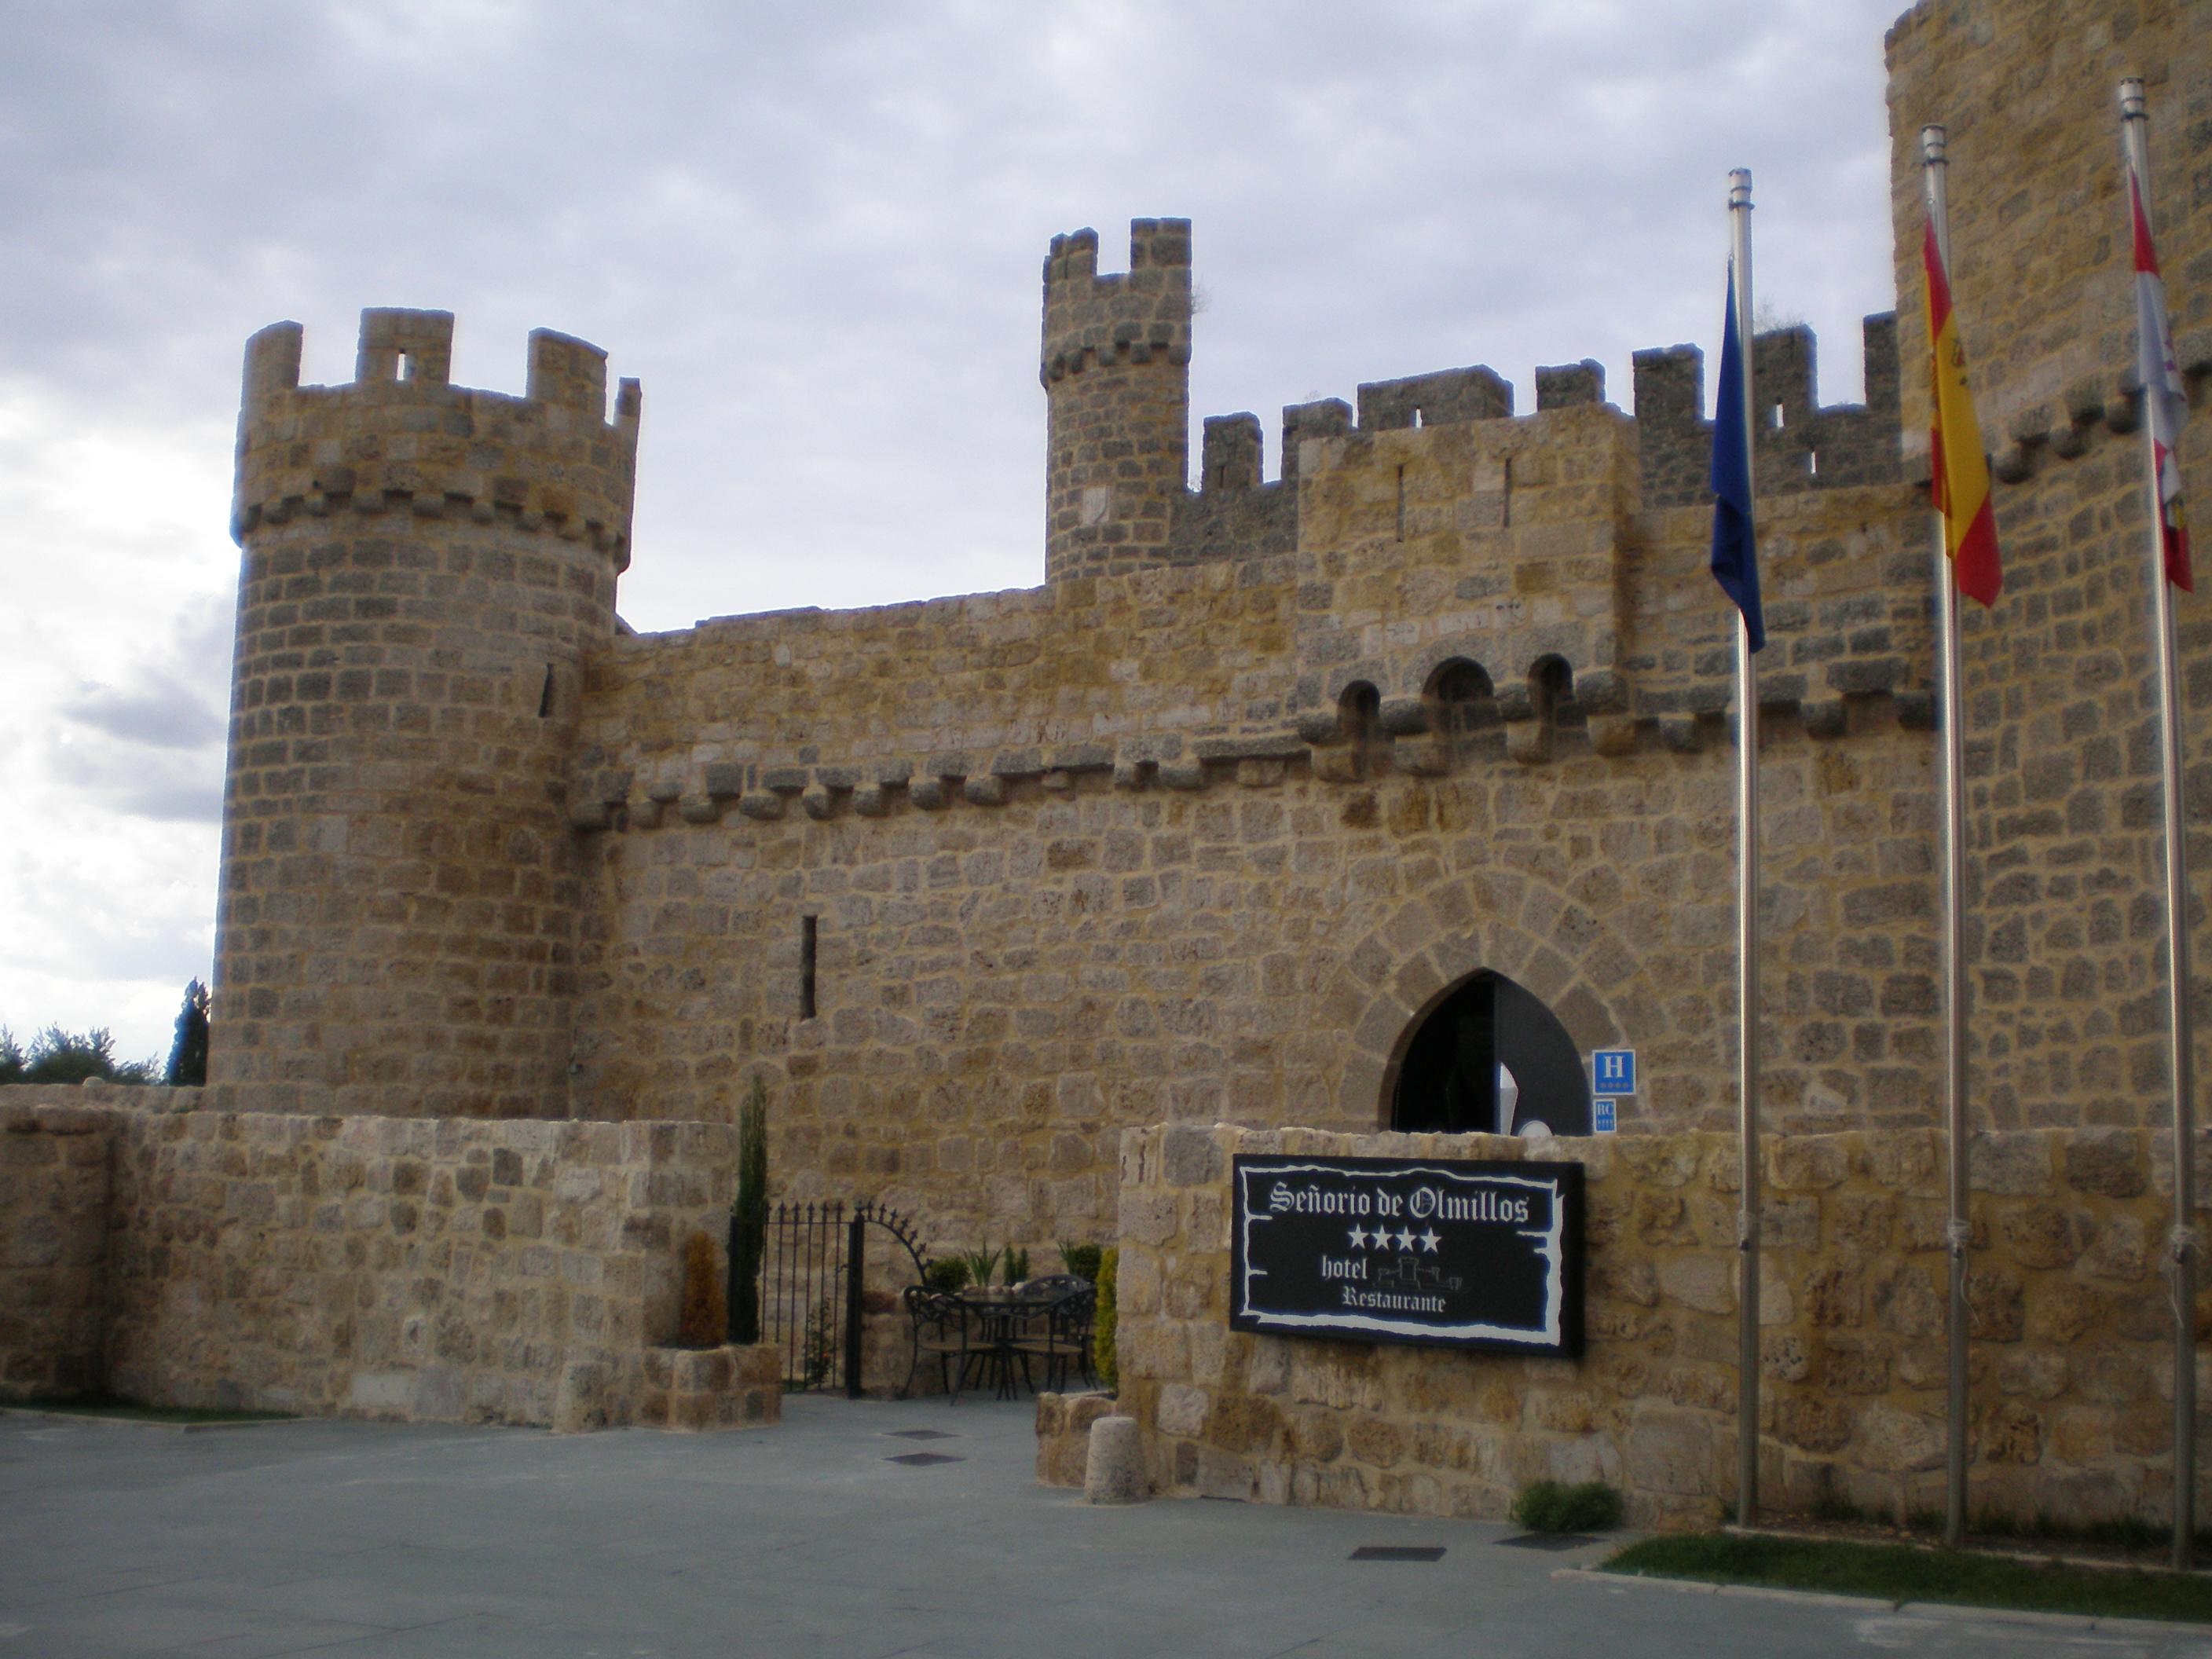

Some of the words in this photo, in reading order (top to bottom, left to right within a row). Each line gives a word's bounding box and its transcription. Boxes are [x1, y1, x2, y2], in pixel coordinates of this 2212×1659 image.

[1604, 1056, 1624, 1078] H
[1377, 1187, 1403, 1217] de
[1409, 1186, 1530, 1223] Olmillos
[1321, 1255, 1368, 1281] hotel
[1342, 1286, 1446, 1313] Restaurante
